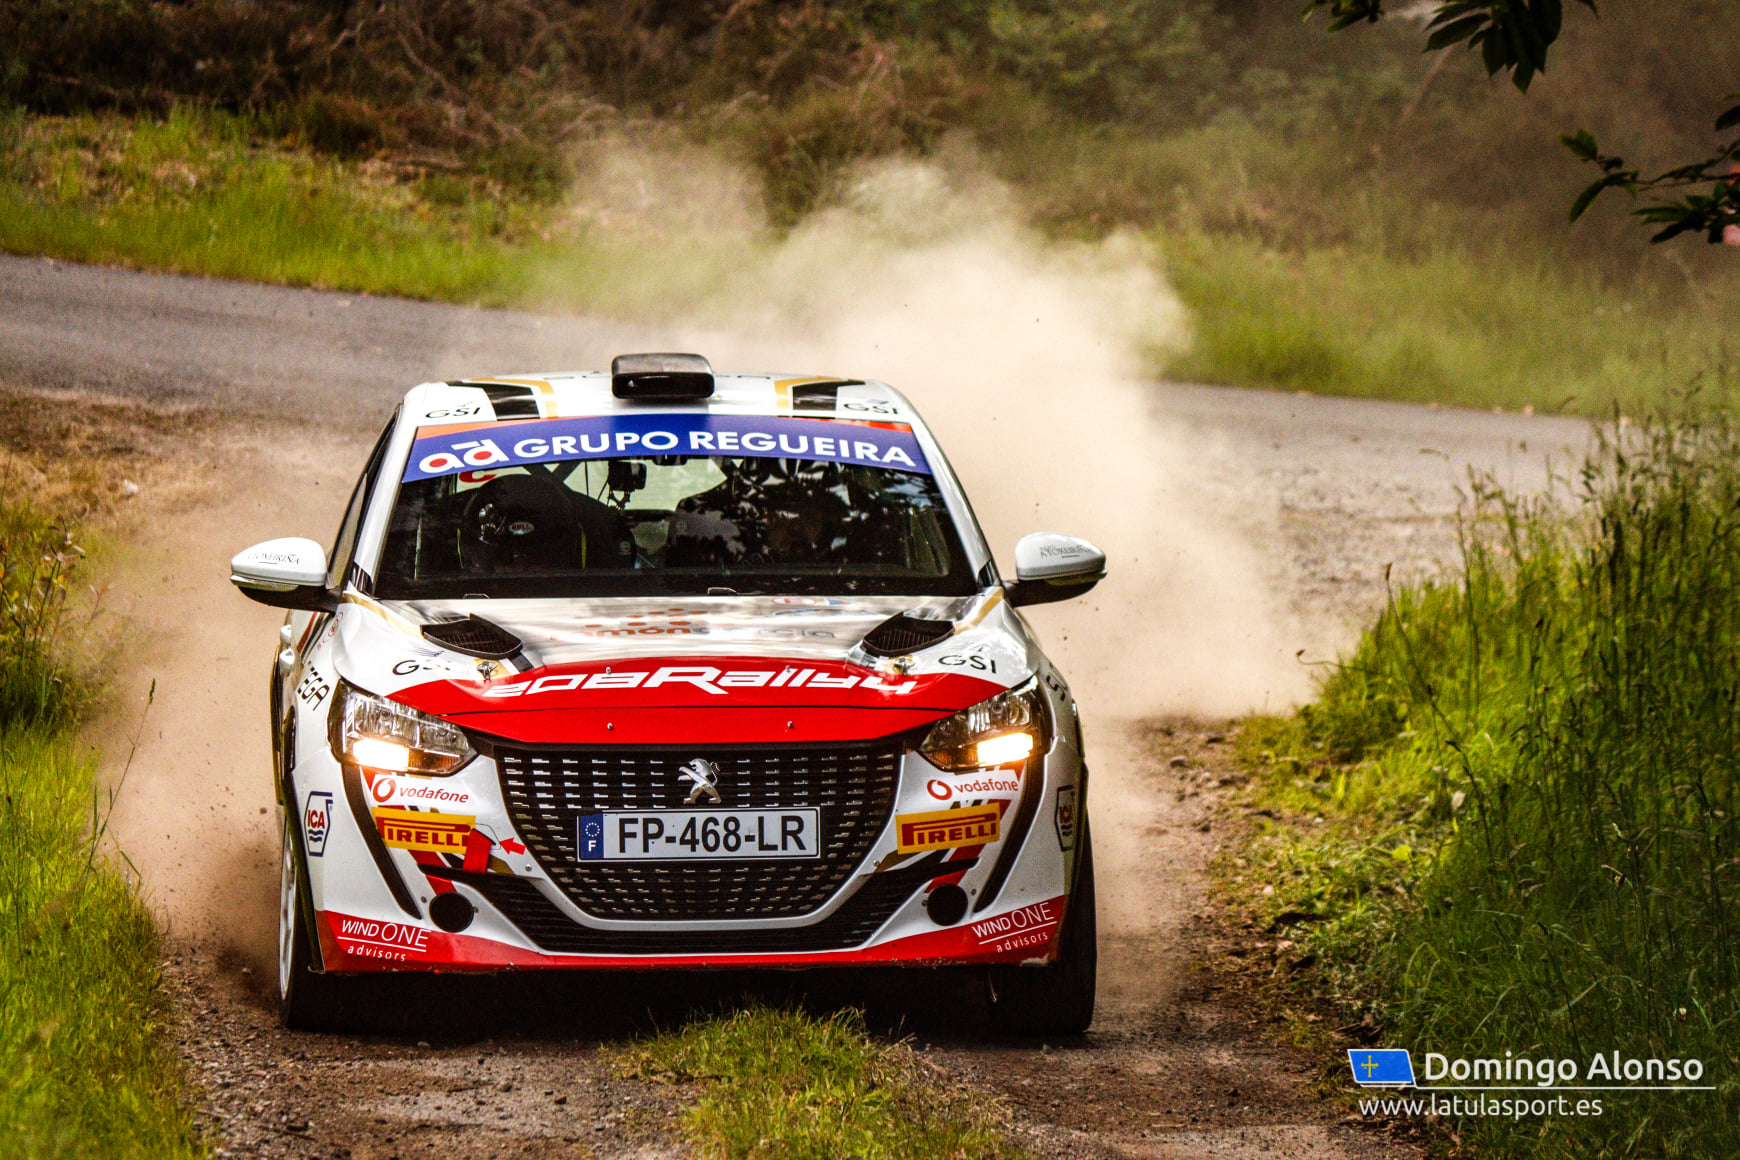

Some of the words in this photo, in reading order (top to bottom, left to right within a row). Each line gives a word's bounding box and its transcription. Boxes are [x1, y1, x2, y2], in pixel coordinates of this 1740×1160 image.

[425, 407, 481, 419] GSI
[843, 402, 899, 415] GSI
[513, 431, 679, 459] GRUPO
[689, 431, 916, 467] REGUEIRA
[938, 654, 997, 674] GSI
[398, 785, 470, 804] vodafone
[953, 778, 1019, 794] vodafone
[307, 809, 326, 829] ICA
[618, 814, 807, 854] FP-468-LR
[901, 812, 998, 848] PIRELLI
[587, 839, 598, 852] F
[996, 930, 1048, 953] advisors
[347, 943, 407, 962] advisors
